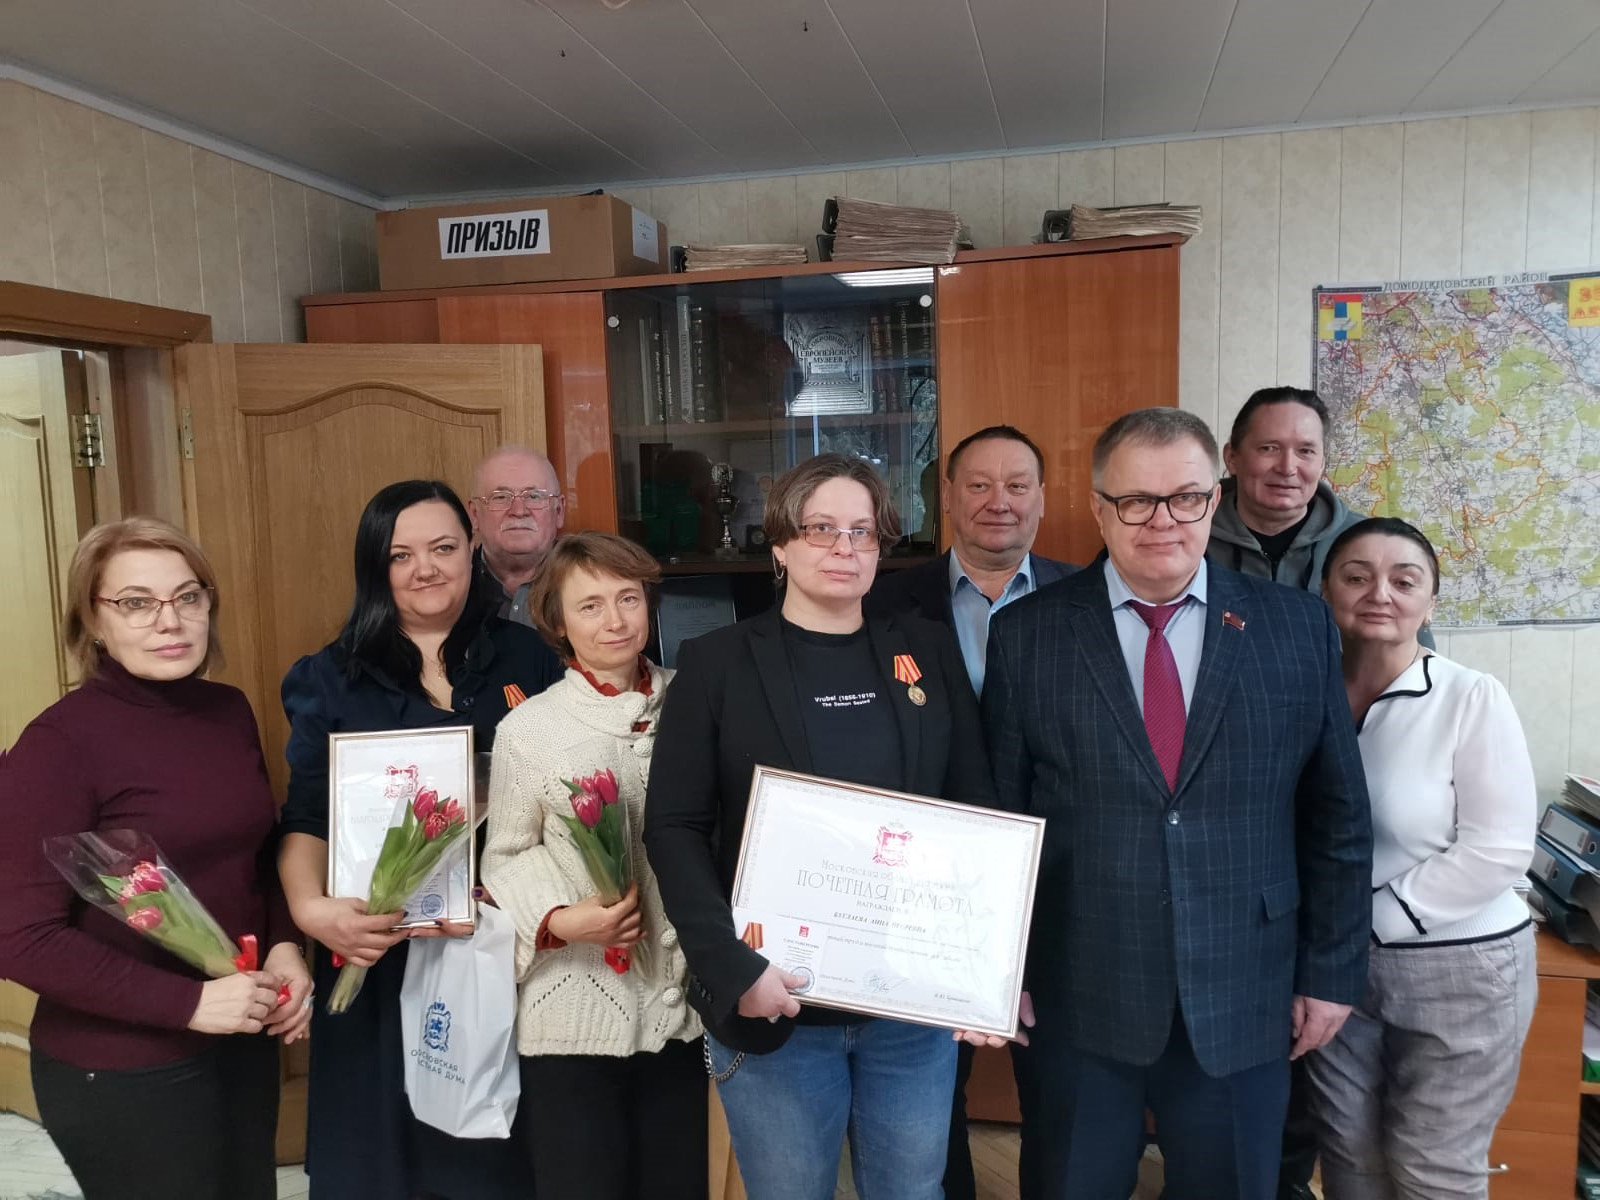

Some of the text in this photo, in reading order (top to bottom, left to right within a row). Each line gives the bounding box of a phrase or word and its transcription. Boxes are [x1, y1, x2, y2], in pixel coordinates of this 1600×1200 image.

[447, 217, 541, 254] ПРИЗЫВ
[1504, 272, 1548, 285] РАЙОН
[813, 356, 844, 364] МУЗЕЕВ
[814, 694, 837, 703] Vrubel
[797, 869, 890, 901] ПОЧЕТНАЯ
[893, 886, 973, 917] ГРАМОТА
